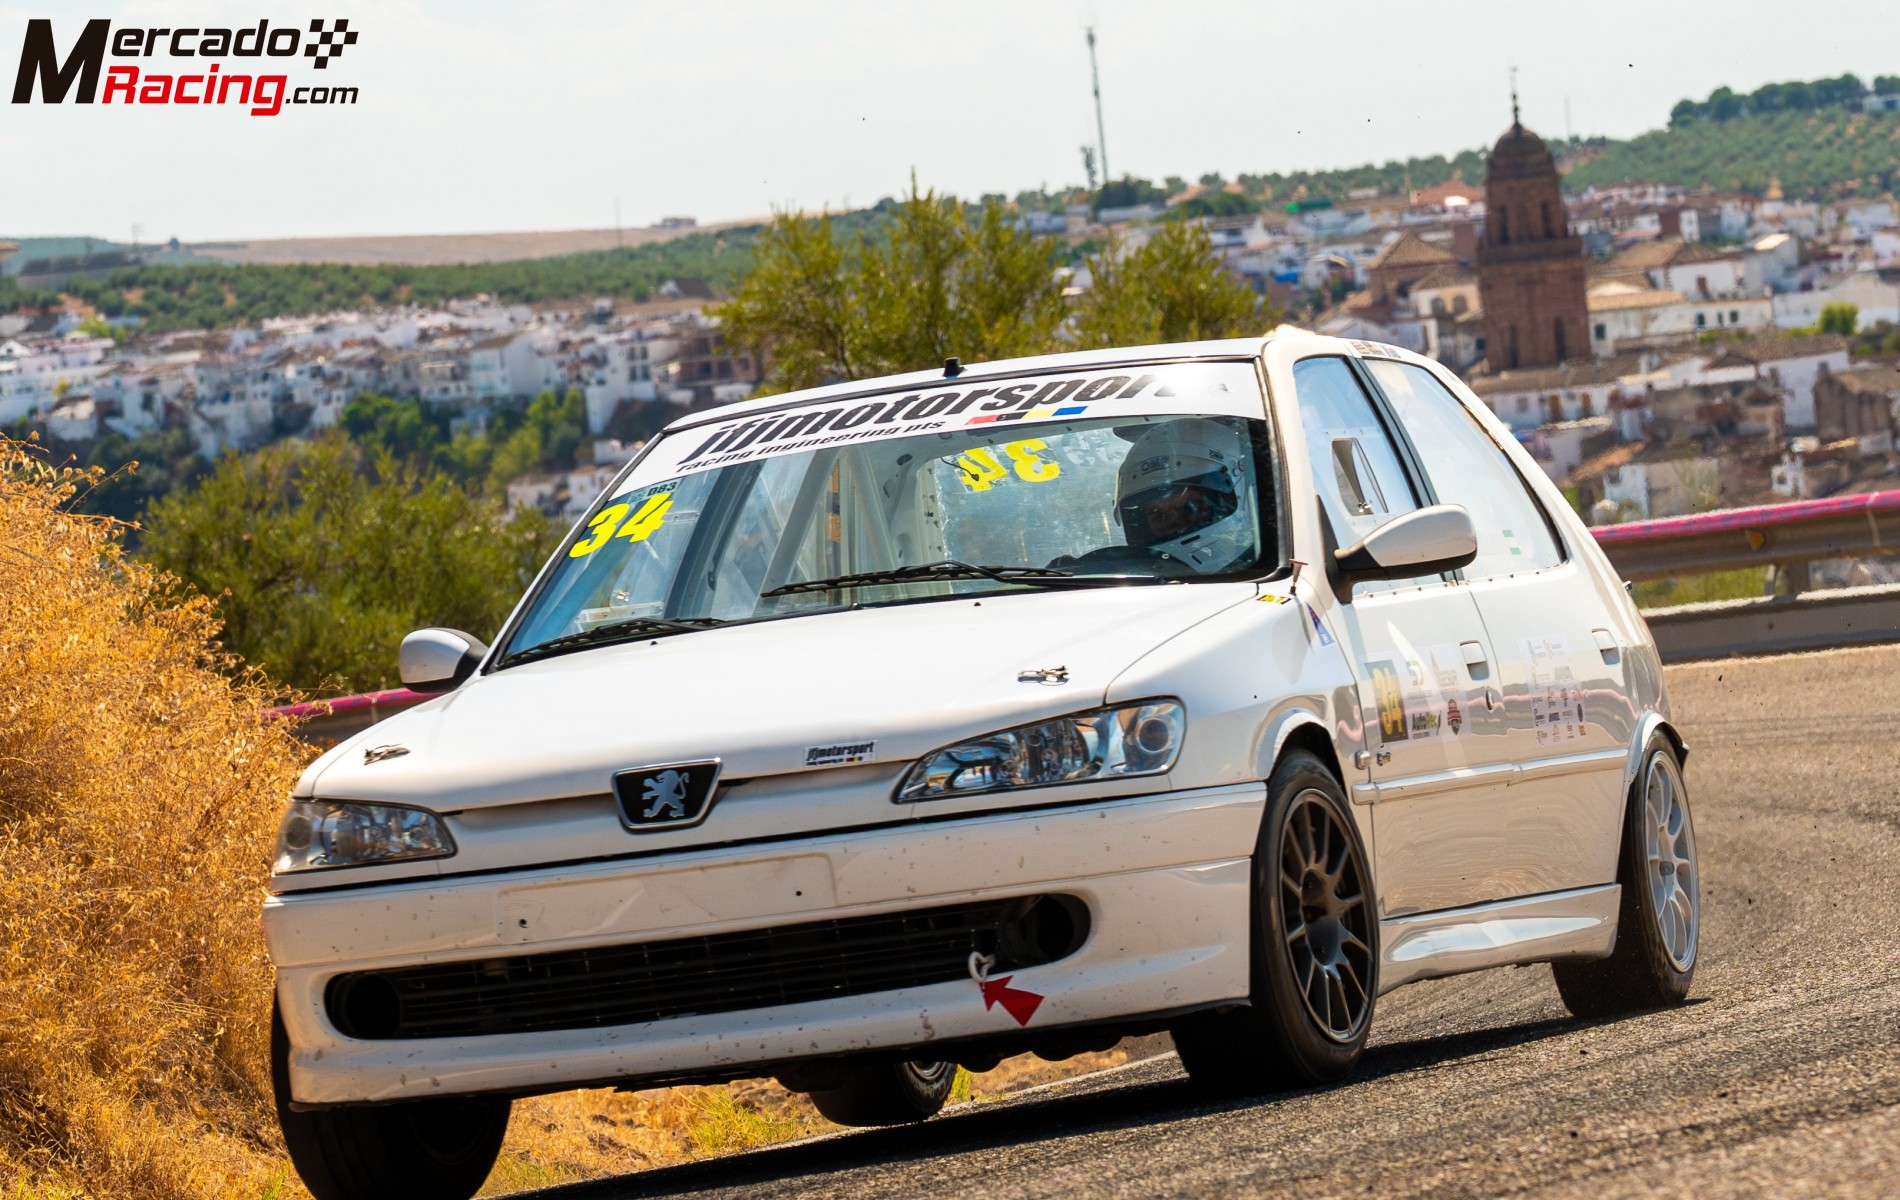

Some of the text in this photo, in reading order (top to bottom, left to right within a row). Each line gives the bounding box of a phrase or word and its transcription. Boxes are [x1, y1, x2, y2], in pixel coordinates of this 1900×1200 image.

[676, 450, 755, 472] racing
[903, 420, 946, 433] pts
[677, 374, 1177, 465] jfjmotorspor
[569, 492, 674, 558] 34
